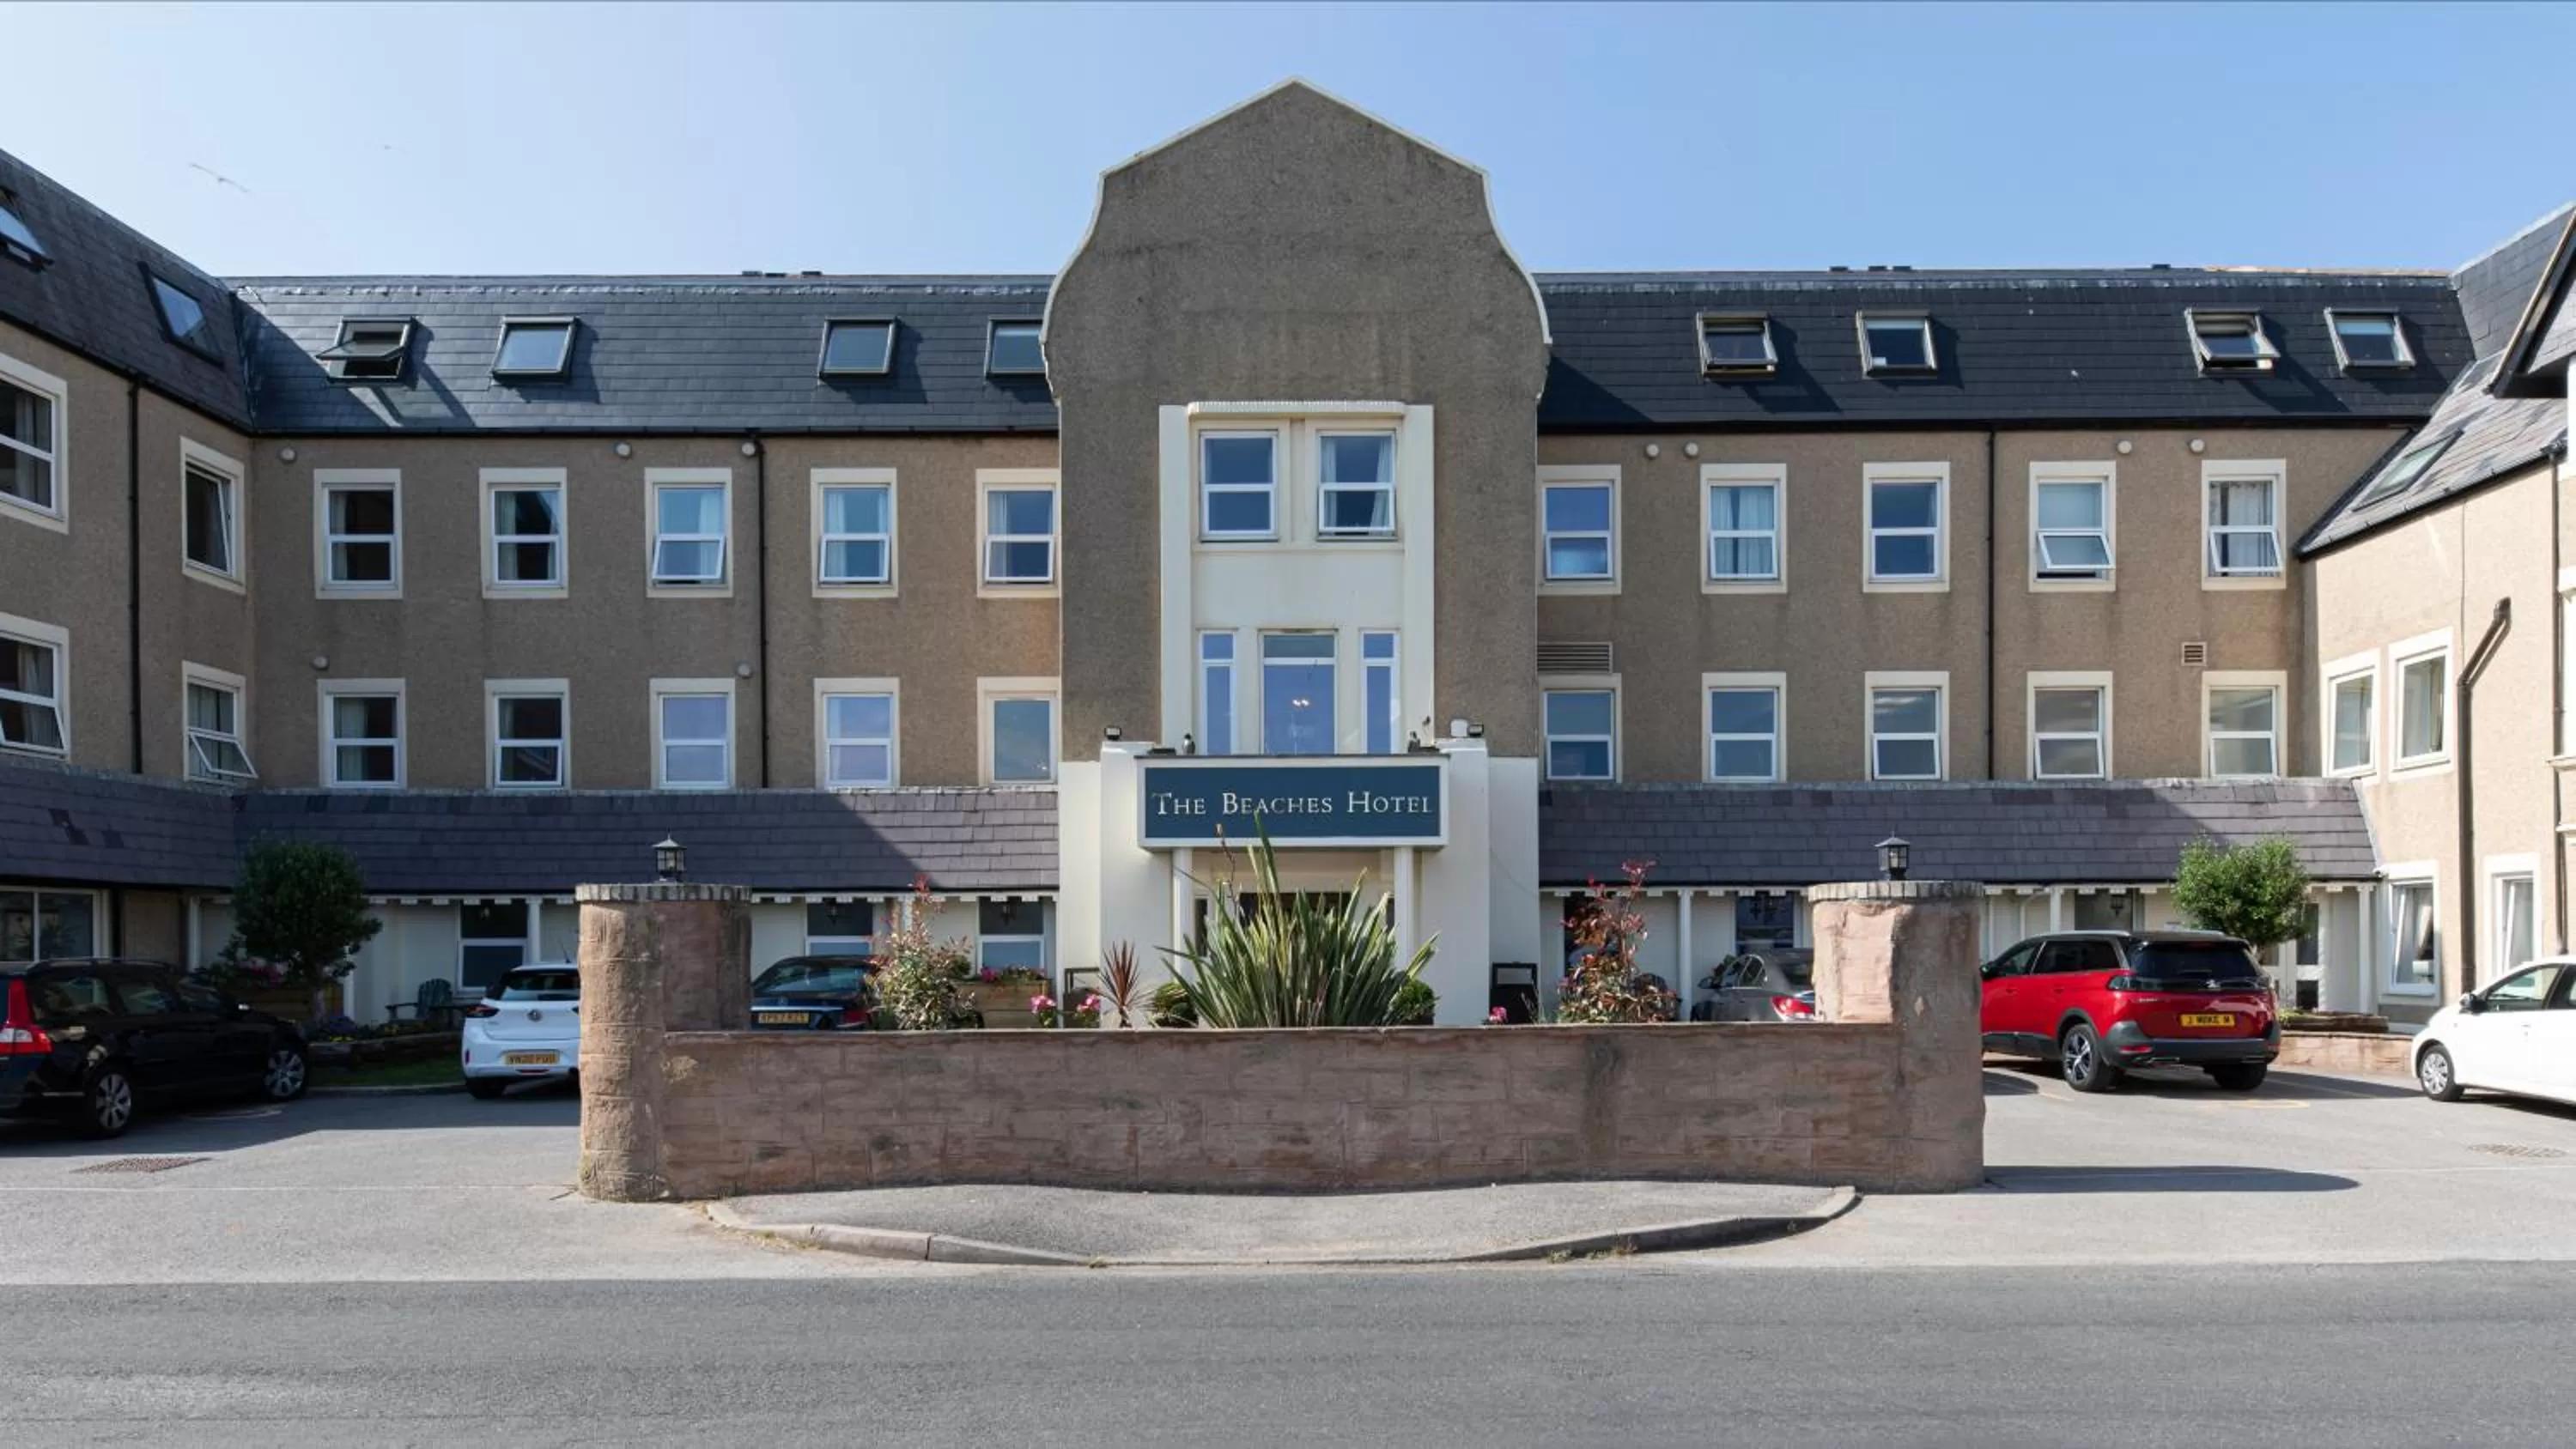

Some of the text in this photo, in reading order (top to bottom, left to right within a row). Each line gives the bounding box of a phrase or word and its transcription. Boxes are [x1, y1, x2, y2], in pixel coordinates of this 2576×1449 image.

[1151, 791, 1432, 815] THE BEACHES HOTEL
